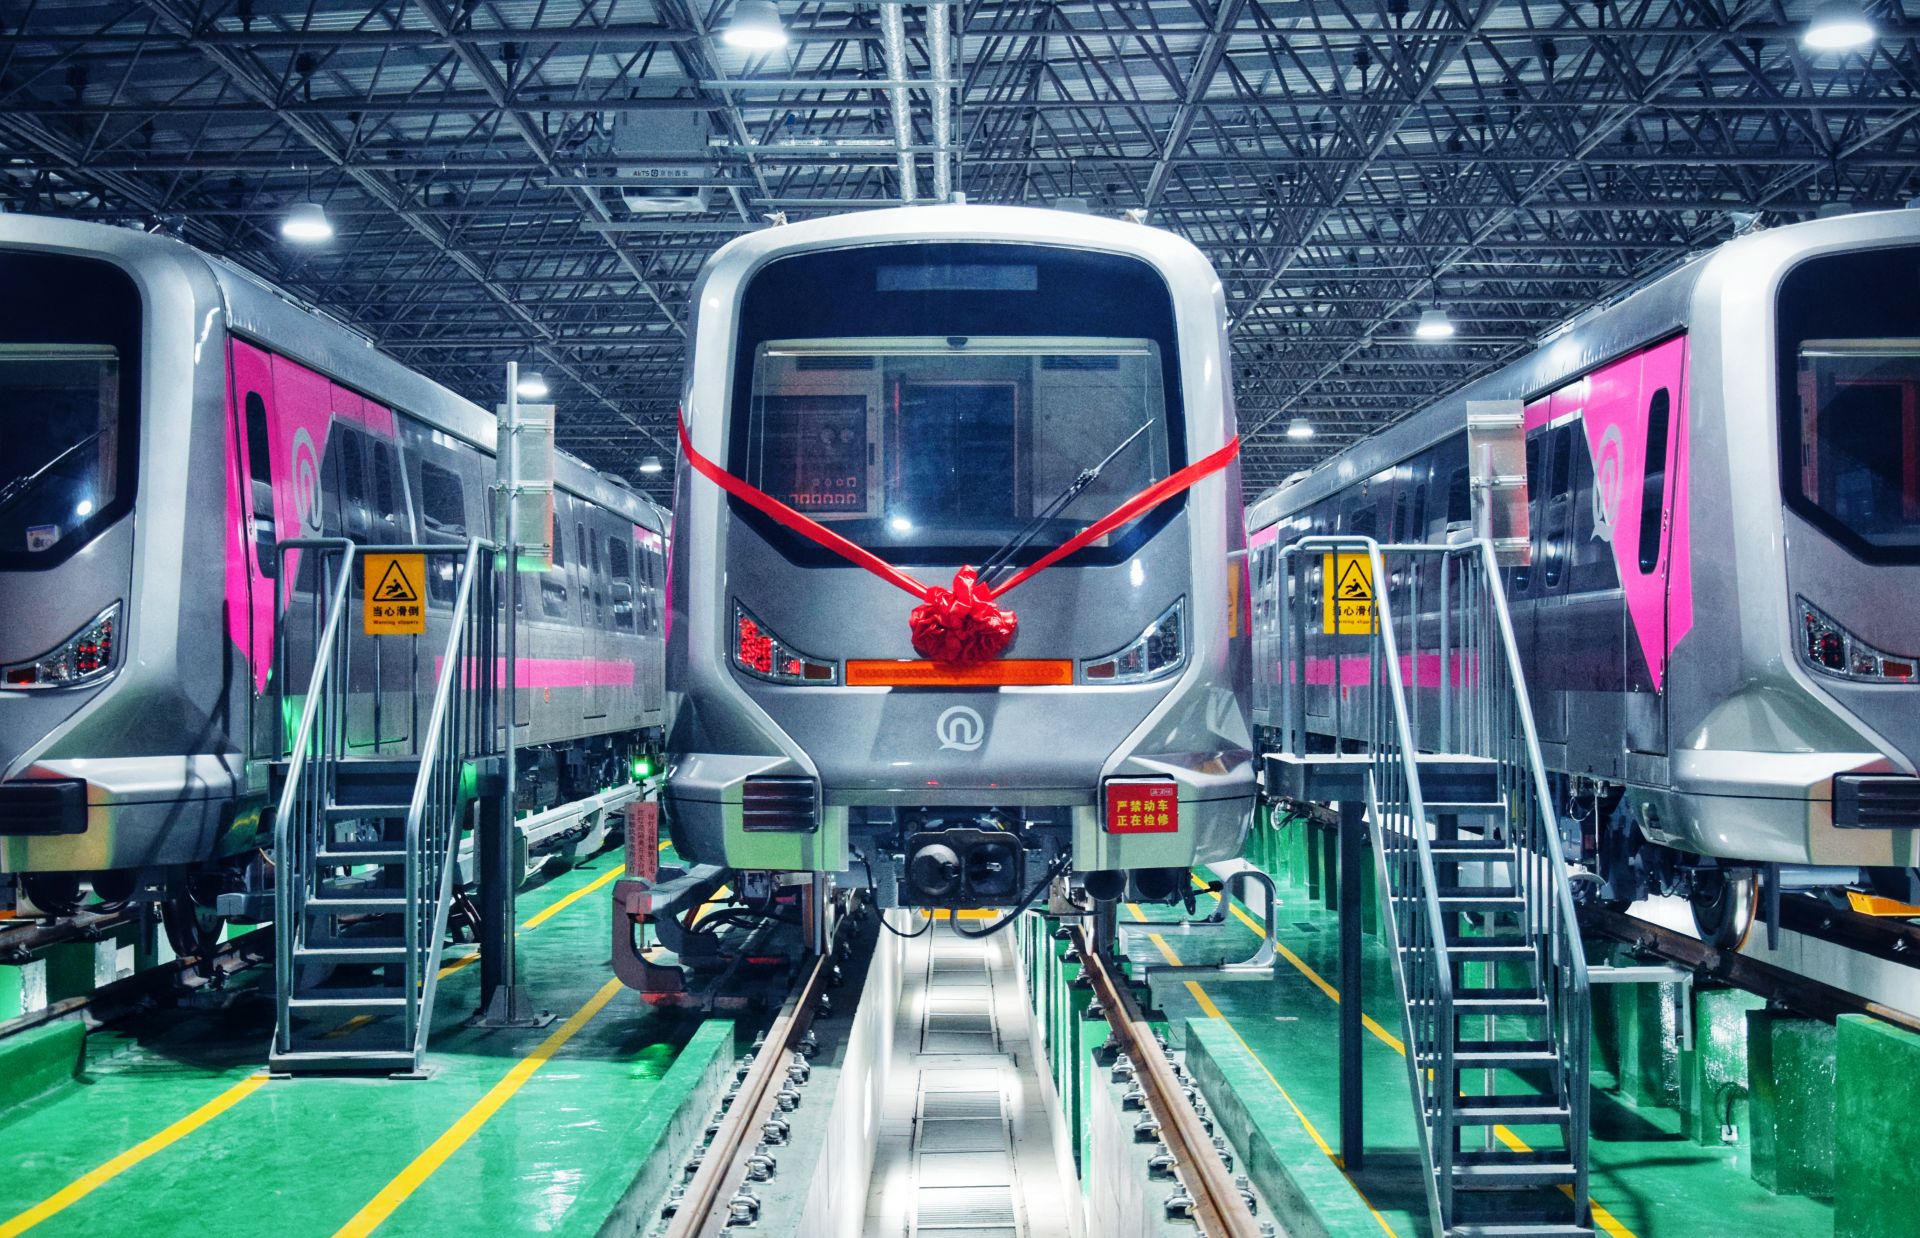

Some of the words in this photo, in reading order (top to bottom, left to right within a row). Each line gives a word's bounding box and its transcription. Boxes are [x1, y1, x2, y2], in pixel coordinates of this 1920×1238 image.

[373, 605, 419, 617] 当心滑倒
[1117, 800, 1169, 813] 严禁动车
[1117, 814, 1169, 826] 正在检修
